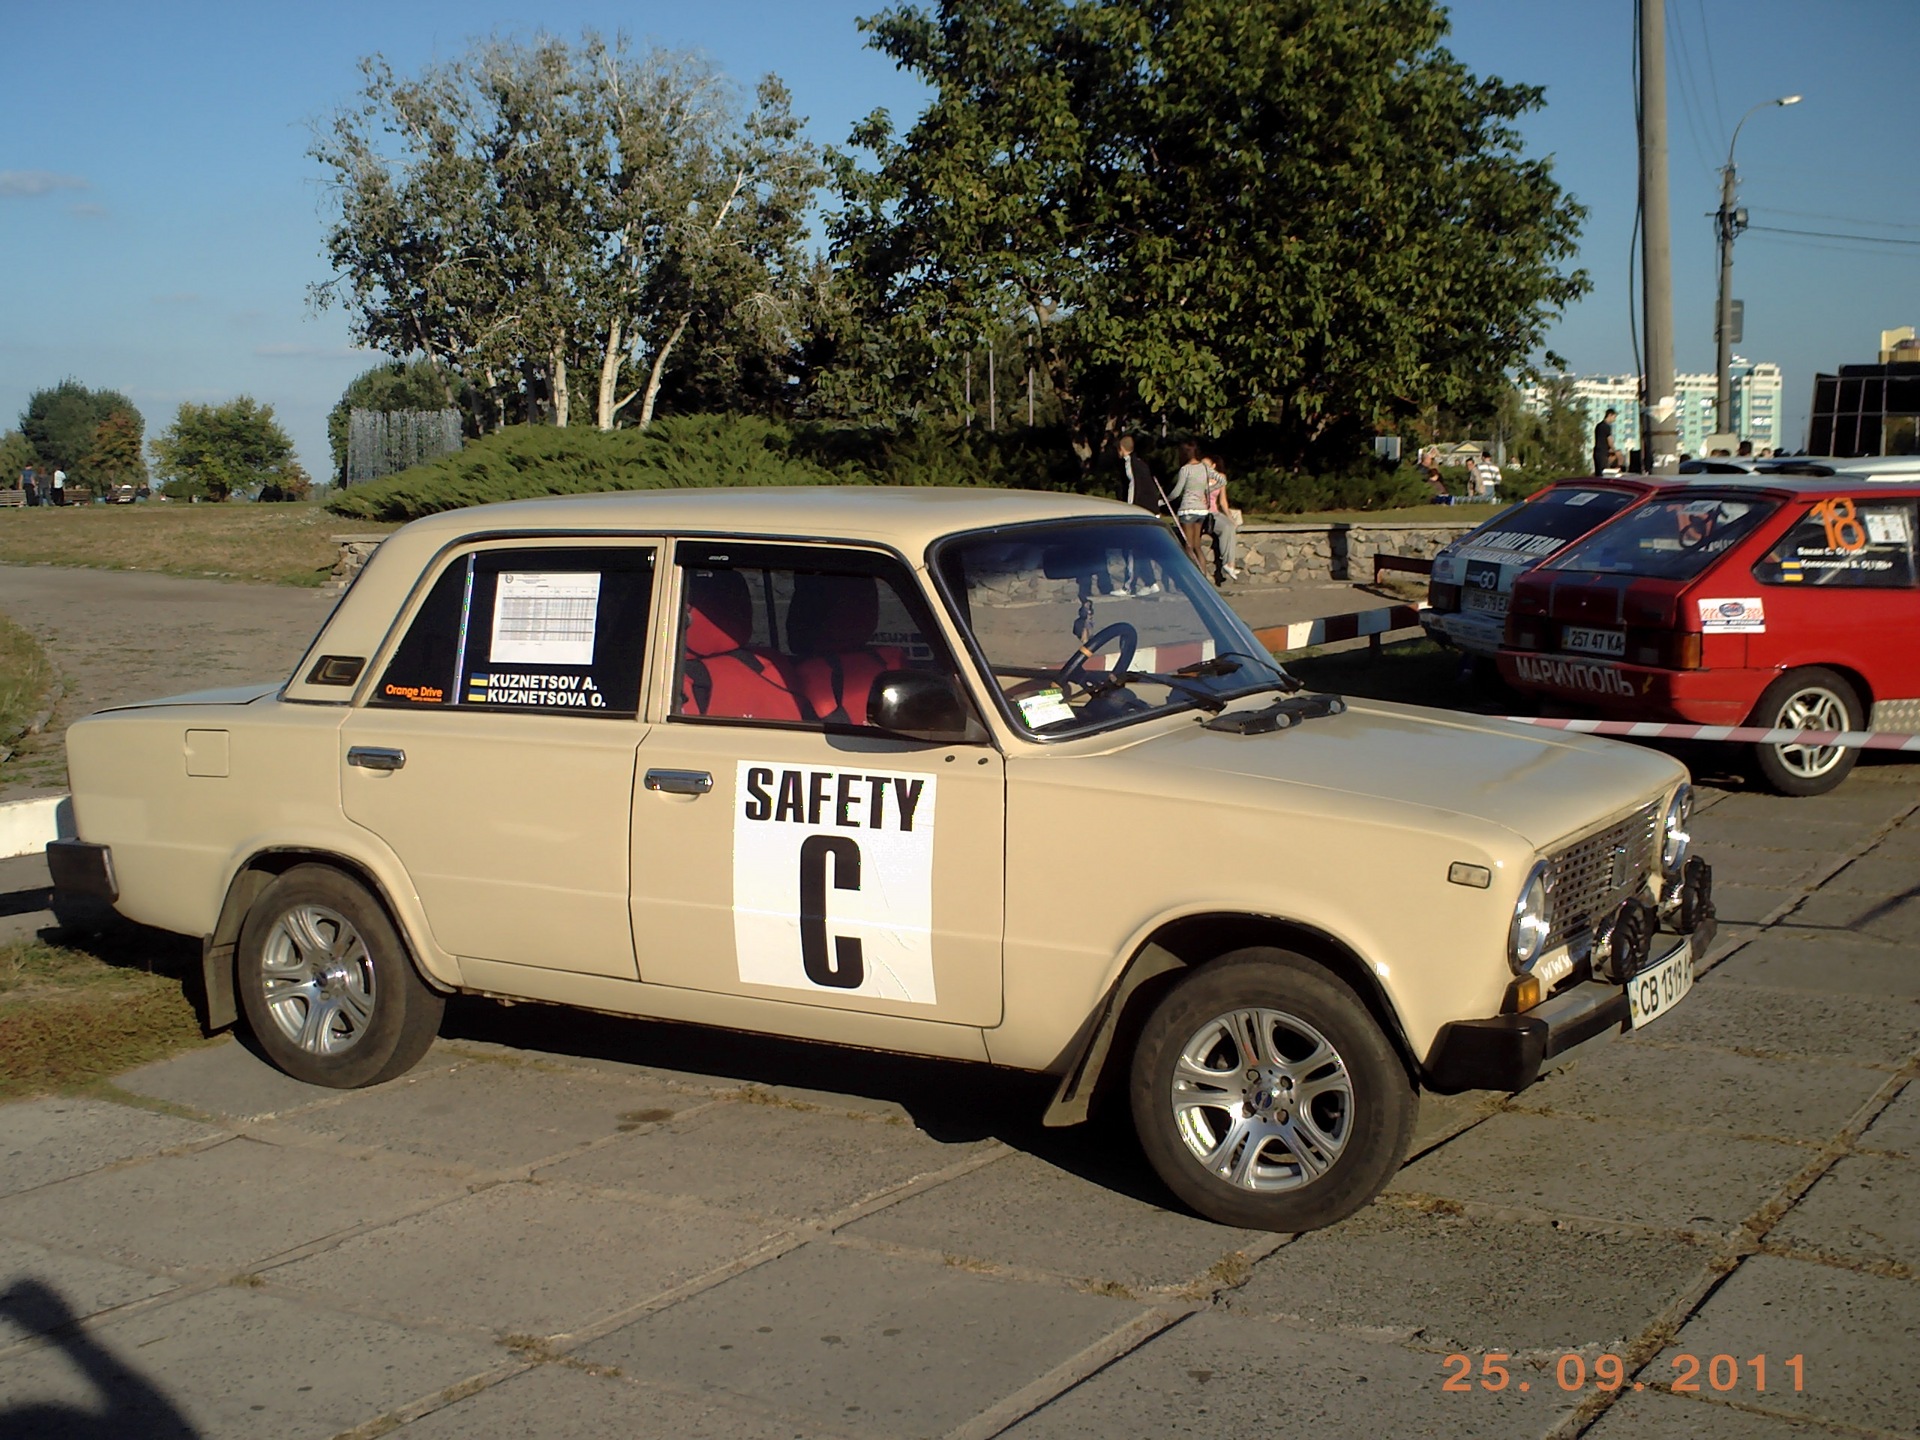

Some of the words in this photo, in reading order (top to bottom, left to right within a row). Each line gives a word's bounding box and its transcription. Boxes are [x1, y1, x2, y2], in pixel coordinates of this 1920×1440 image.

[1810, 497, 1865, 551] 18
[1519, 535, 1567, 556] TEAM
[1479, 570, 1496, 589] GO
[386, 684, 419, 698] Orange
[420, 686, 443, 697] Drive
[489, 673, 580, 690] KUZNETSOV
[582, 676, 597, 690] A.
[1515, 655, 1635, 697] МАРИУПОЛЬ
[487, 689, 587, 706] KUZNETSOVA
[591, 693, 606, 707] O.
[745, 767, 924, 832] SAFETY
[800, 834, 864, 989] C
[1640, 975, 1659, 1015] CB
[1662, 960, 1682, 1004] 1319
